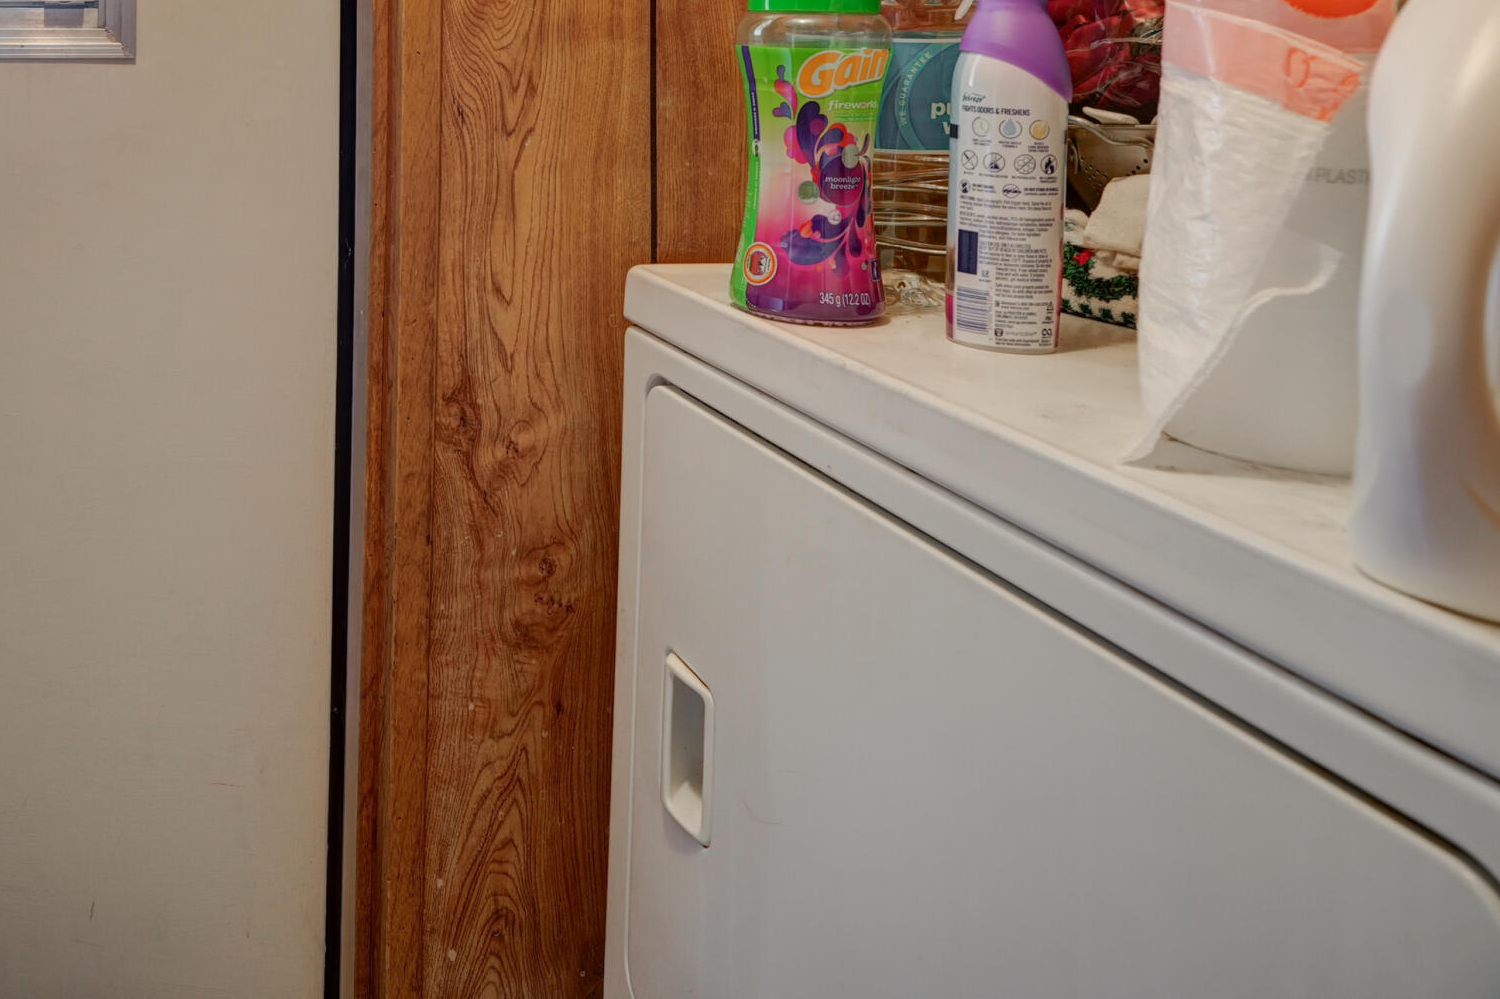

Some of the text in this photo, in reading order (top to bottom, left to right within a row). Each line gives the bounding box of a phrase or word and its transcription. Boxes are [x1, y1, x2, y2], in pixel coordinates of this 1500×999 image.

[799, 49, 889, 97] Gain
[900, 52, 933, 126] WE GUARANTEE
[827, 100, 877, 111] fireworks
[962, 105, 977, 113] FIGHTS
[977, 106, 995, 115] ODORS
[1001, 108, 1032, 116] FRESHENS
[825, 175, 861, 187] moonlight
[819, 291, 835, 306] 345
[835, 294, 842, 308] g
[842, 292, 861, 308] (12.2
